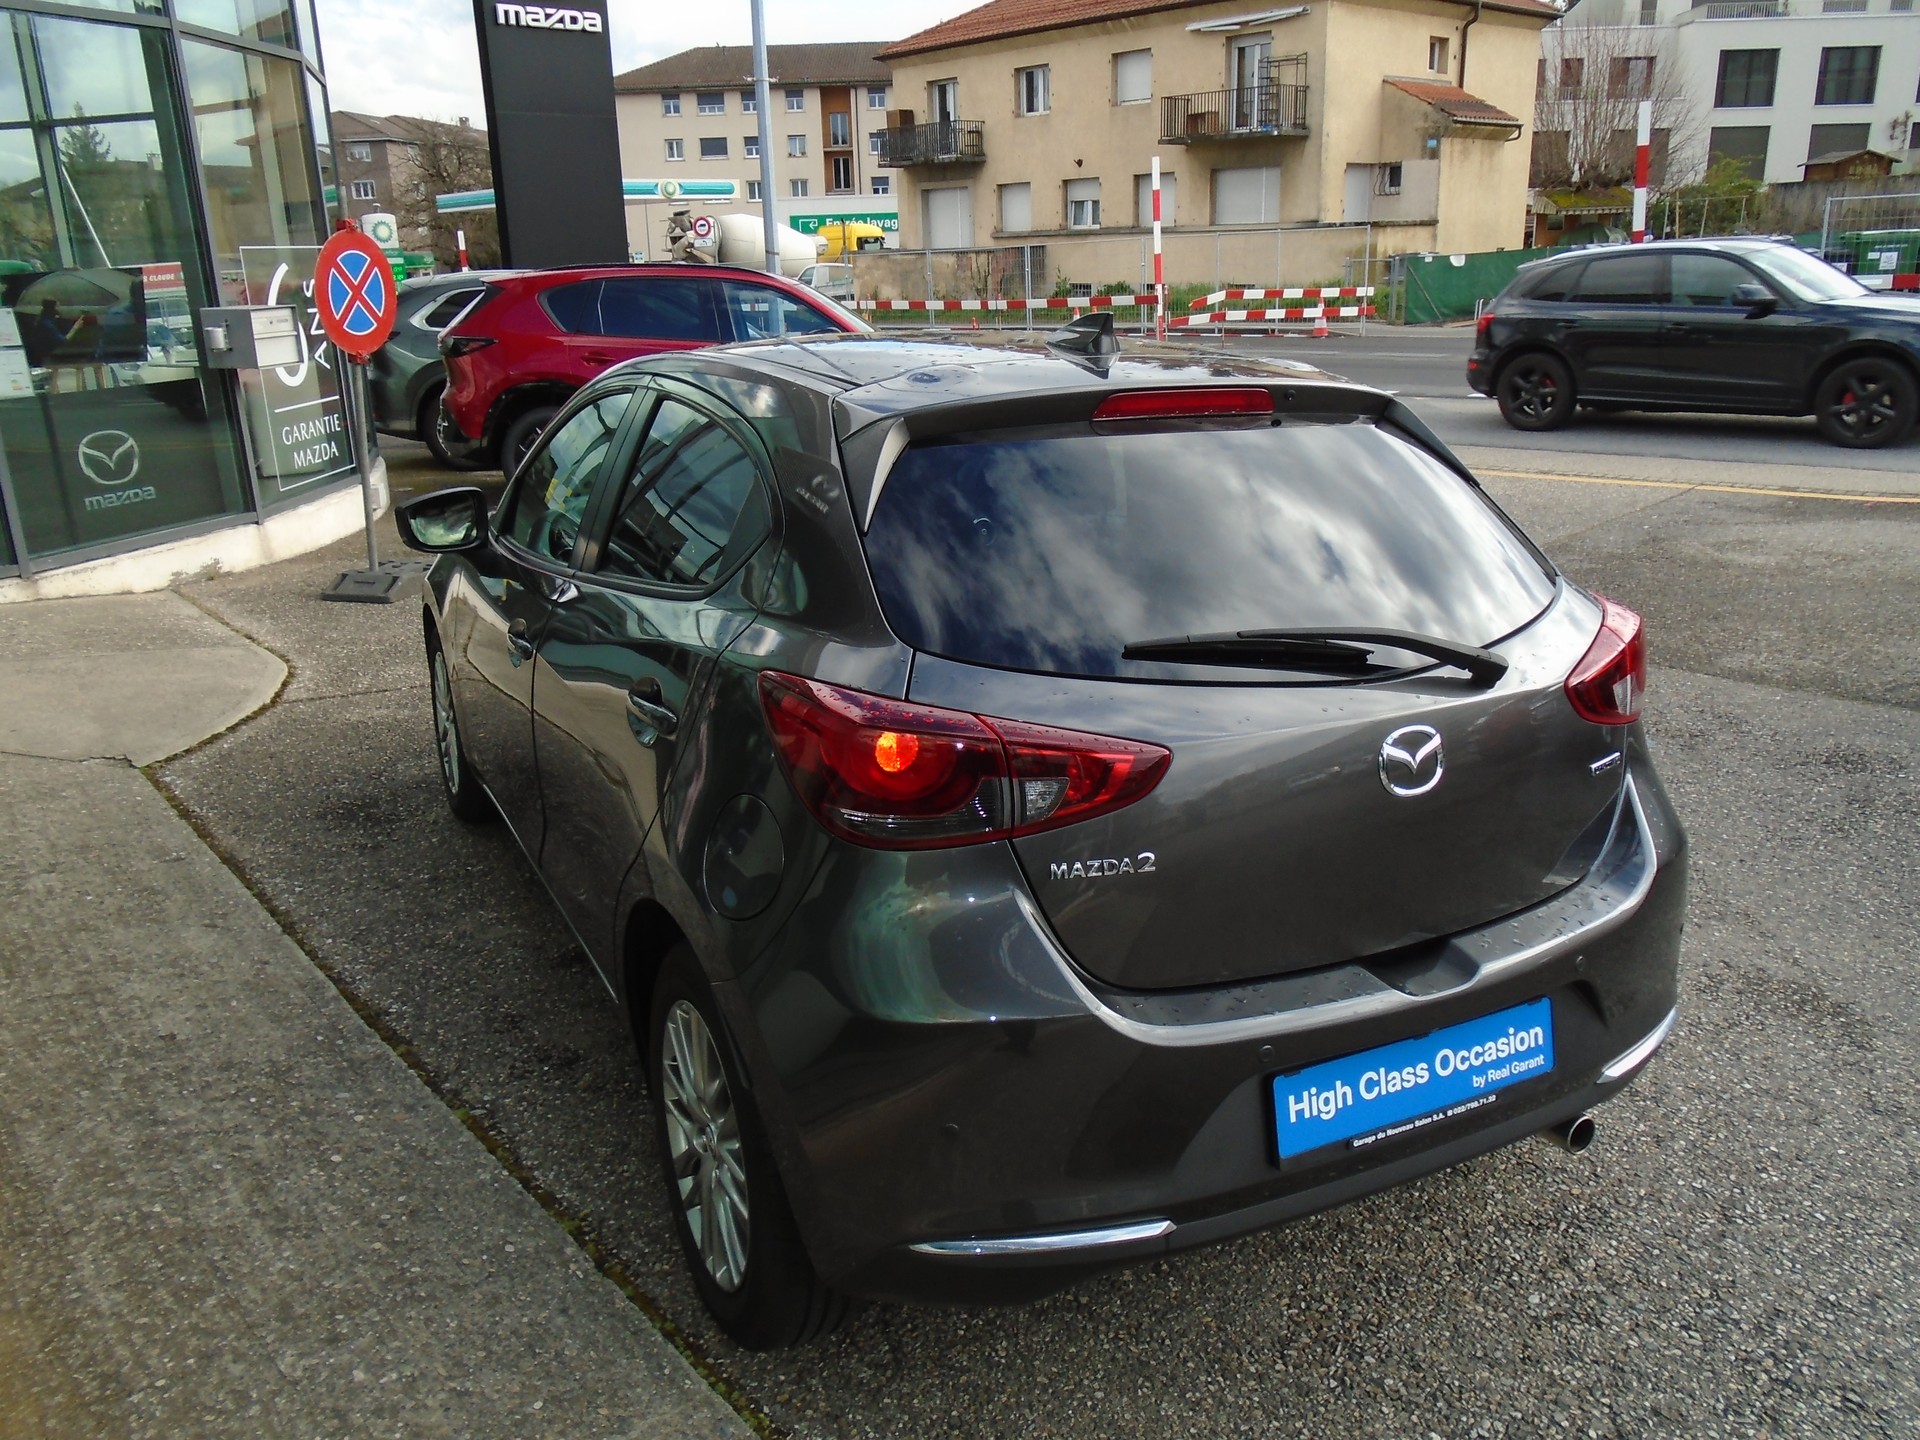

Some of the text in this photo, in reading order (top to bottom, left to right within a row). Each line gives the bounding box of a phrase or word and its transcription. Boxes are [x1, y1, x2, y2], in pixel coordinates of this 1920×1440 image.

[825, 216, 898, 230] Enré lavag
[282, 413, 341, 445] GARANTIE
[293, 440, 339, 470] MAZDA
[1288, 1026, 1544, 1123] High Class Occasion
[1472, 1054, 1545, 1088] by Real Garant
[1353, 1133, 1377, 1147] Garage
[1376, 1130, 1386, 1140] du
[1386, 1122, 1414, 1137] Nouveau
[1414, 1116, 1433, 1128] Salon
